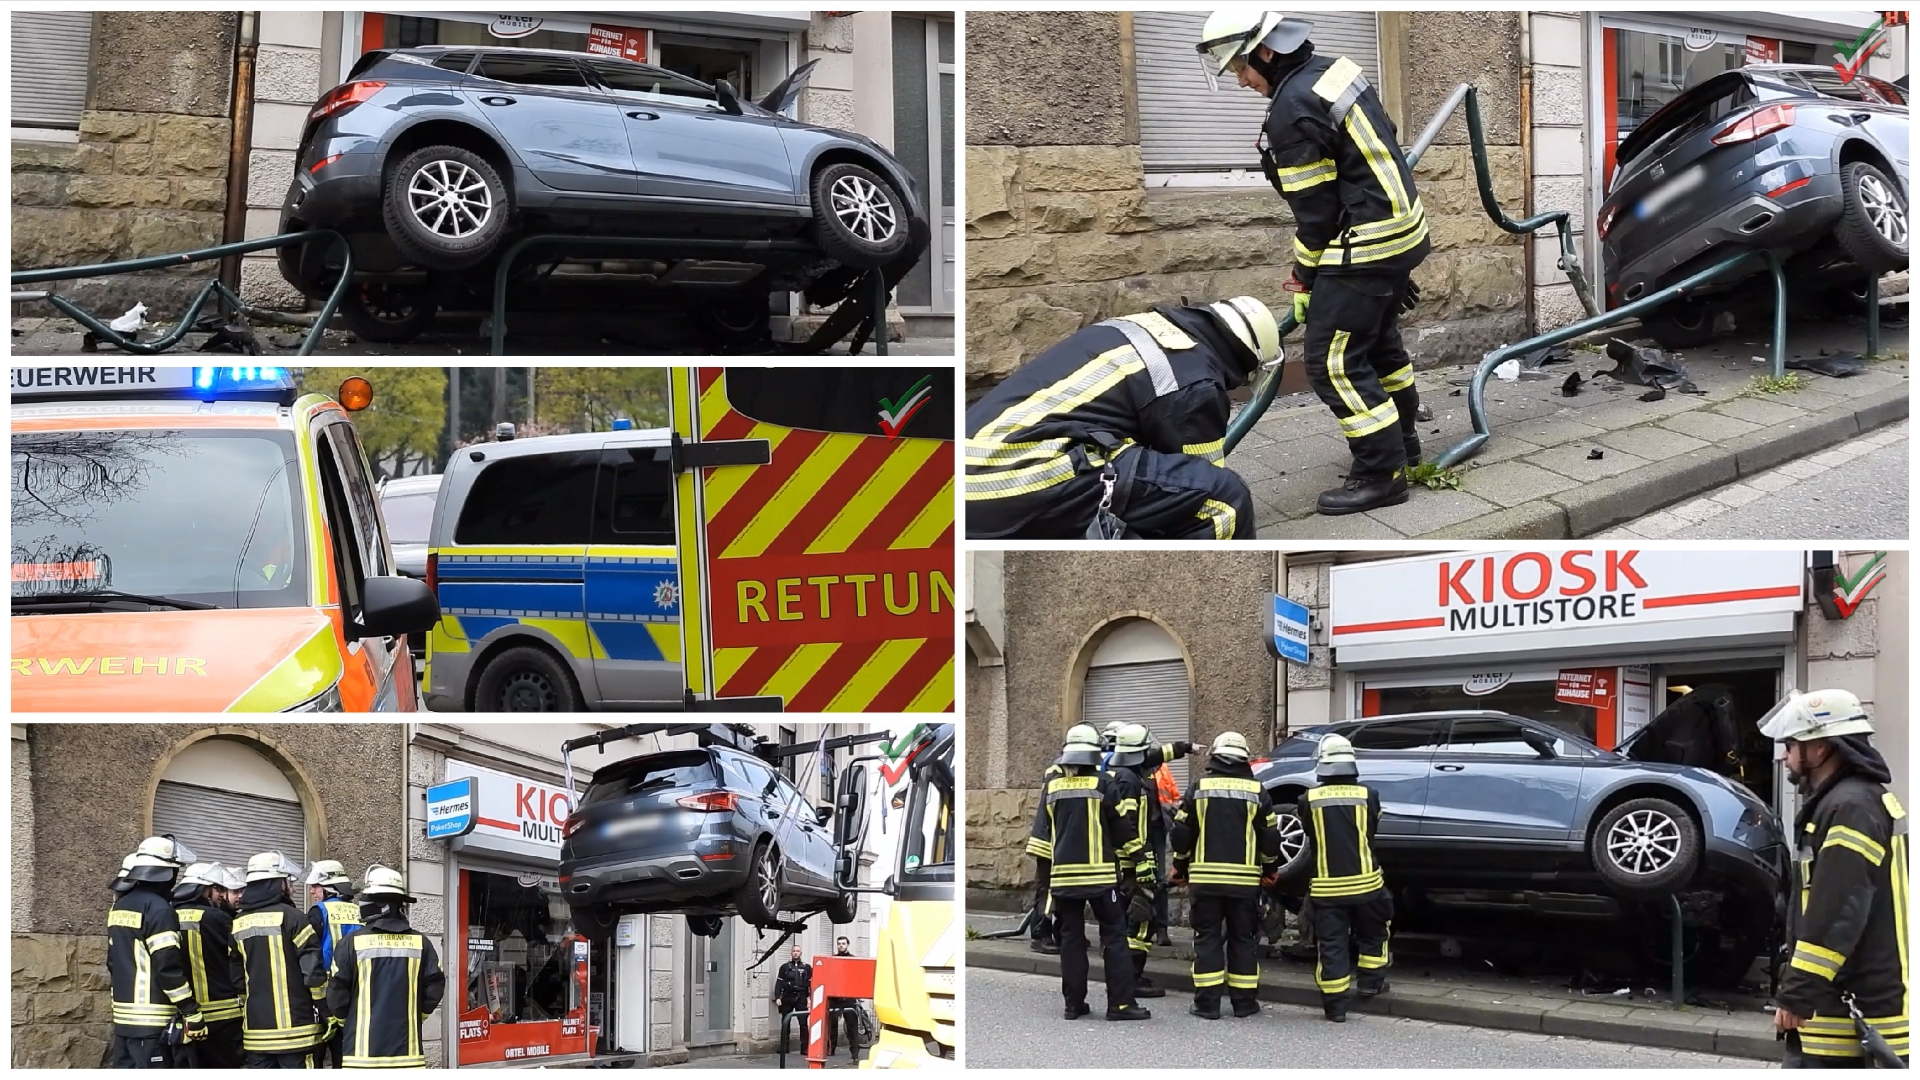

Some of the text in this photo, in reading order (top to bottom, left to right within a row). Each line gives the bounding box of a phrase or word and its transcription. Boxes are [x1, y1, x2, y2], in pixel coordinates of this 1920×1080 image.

[500, 20, 533, 28] MOBILE
[591, 28, 623, 41] INTERNET
[590, 43, 621, 57] ZUHAUSE
[11, 367, 156, 388] UERWEHR
[1439, 550, 1648, 607] KIOSK
[737, 571, 955, 622] RETTUN
[1450, 593, 1636, 632] MULTISTORE
[1282, 622, 1307, 640] Hermes
[1560, 673, 1592, 683] INTERNET
[1557, 688, 1590, 698] ZUHAUSE
[440, 801, 469, 815] Hermes
[430, 821, 462, 833] PaketShop
[460, 1027, 481, 1039] FLATS
[562, 1026, 576, 1035] FLATS
[505, 1045, 550, 1058] ORTEL MOBILE
